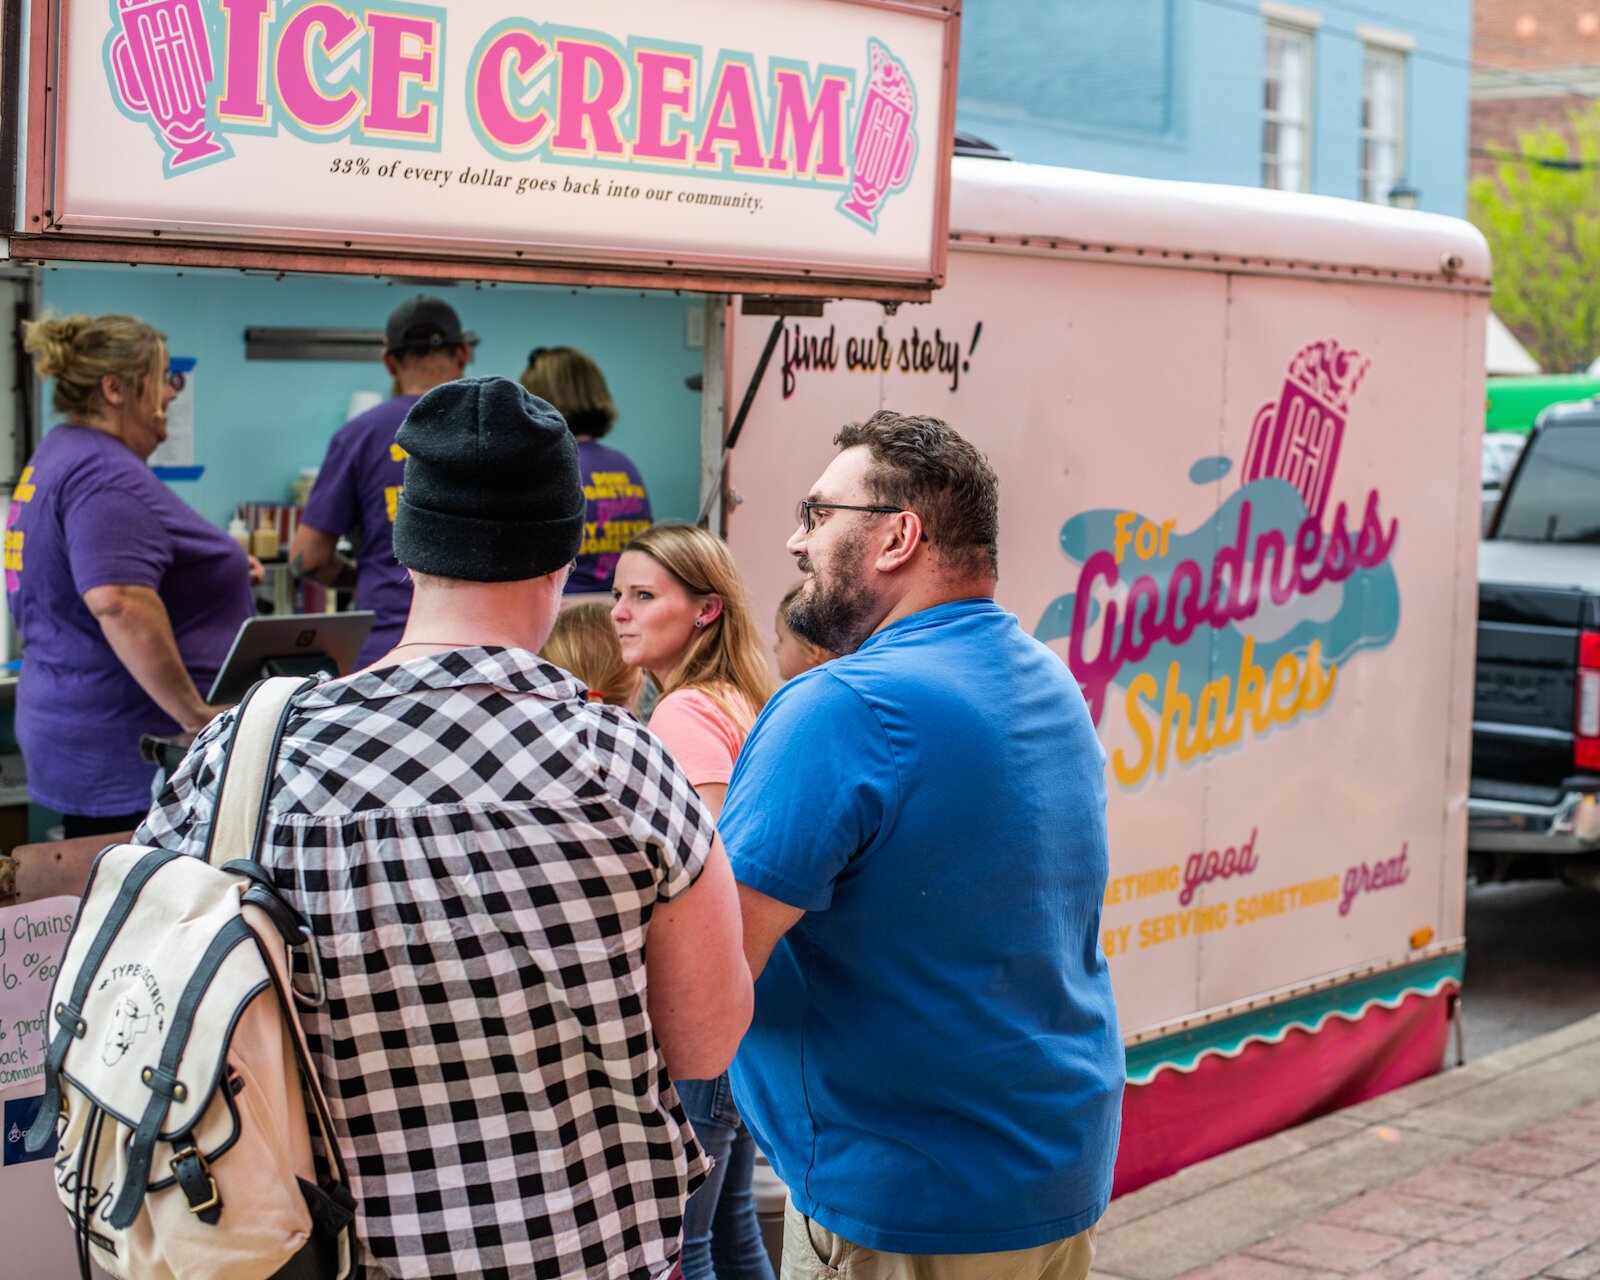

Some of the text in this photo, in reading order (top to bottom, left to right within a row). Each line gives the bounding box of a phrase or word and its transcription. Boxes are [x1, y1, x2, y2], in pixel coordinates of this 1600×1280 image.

[216, 0, 849, 181] ICE CREAM
[330, 157, 764, 214] 33% of every dollar goes back into our community.
[781, 321, 983, 400] find our story!
[1113, 511, 1177, 565] For
[1068, 488, 1398, 730] Goodness
[1112, 635, 1338, 786] Shakes
[1103, 841, 1410, 958] BY SERVING SOMETHING great
[1179, 826, 1259, 907] good
[13, 914, 73, 943] Chains
[112, 964, 141, 980] TYPE
[0, 1046, 29, 1065] ack
